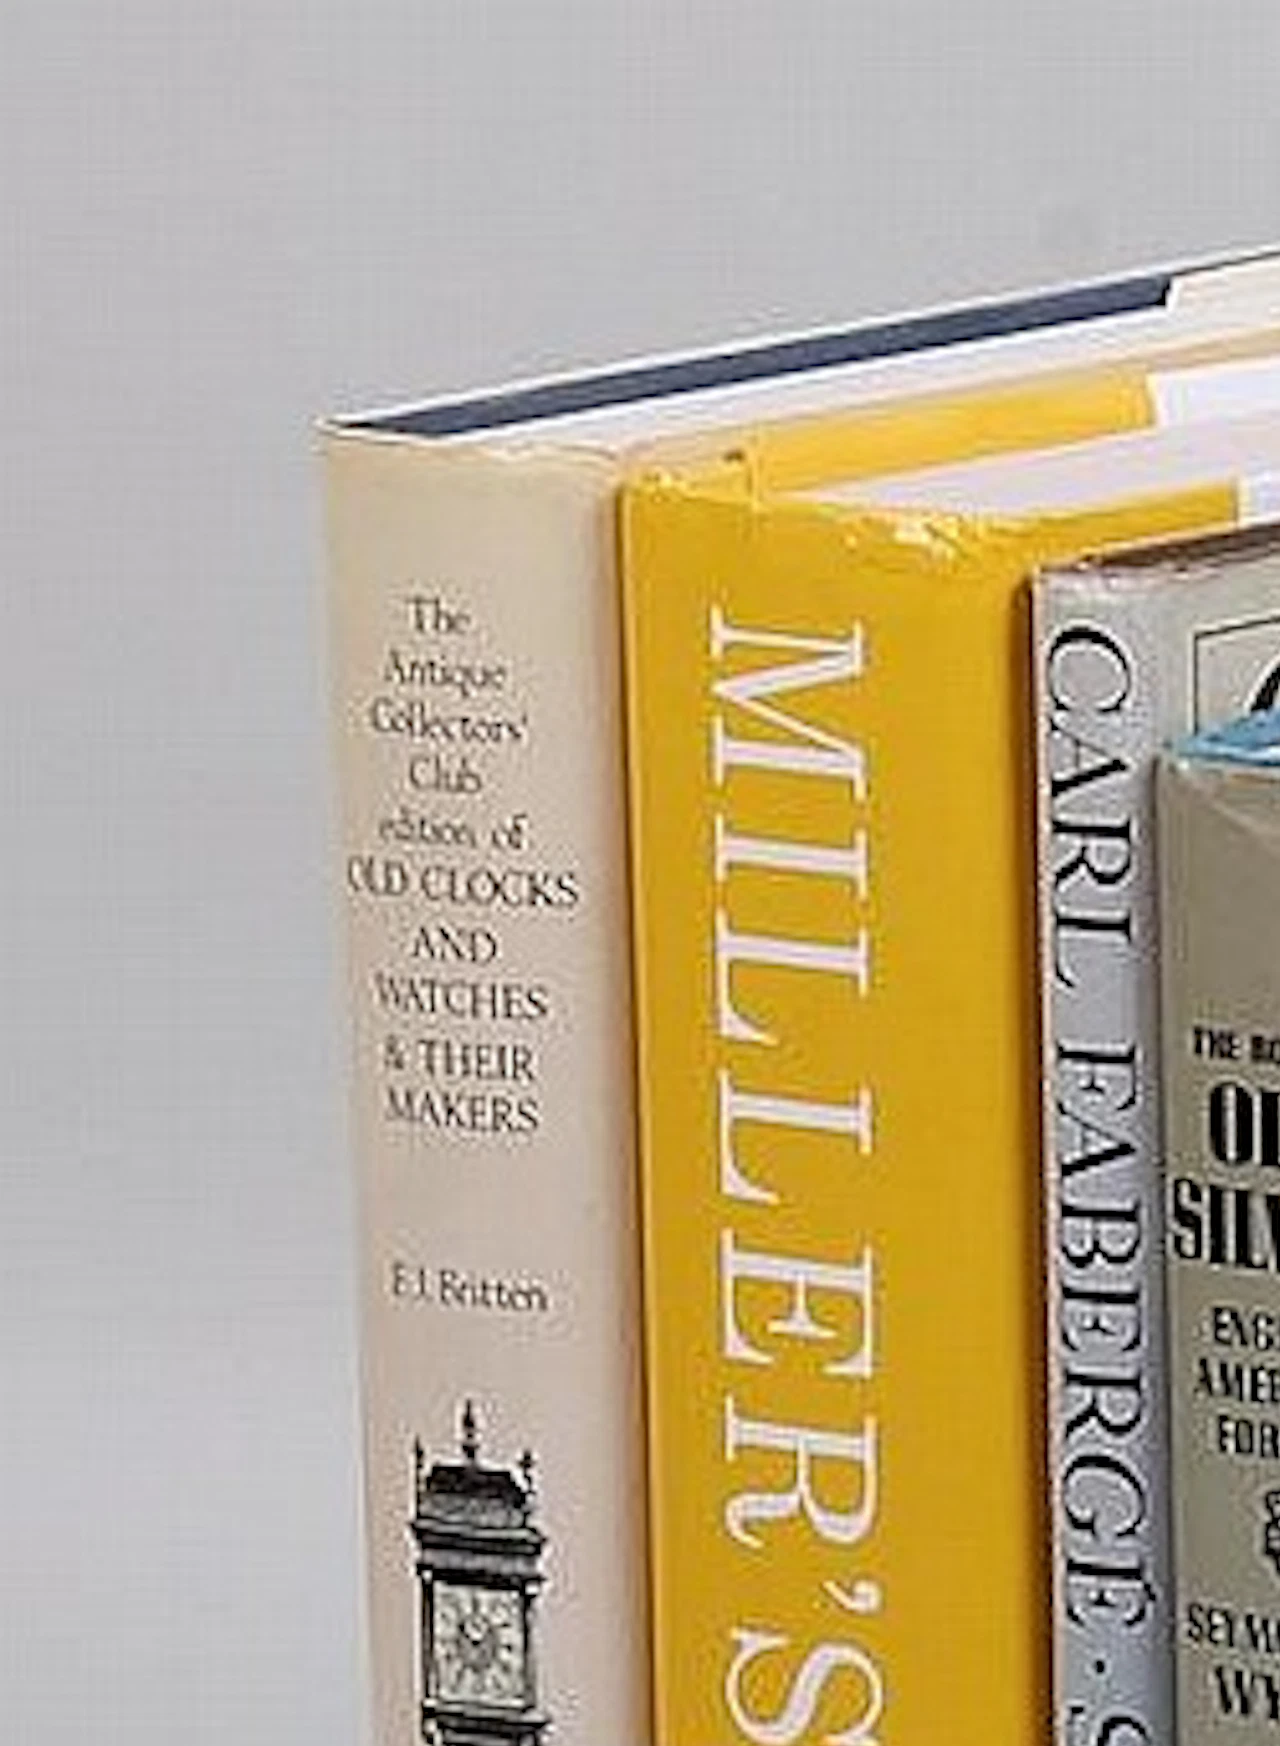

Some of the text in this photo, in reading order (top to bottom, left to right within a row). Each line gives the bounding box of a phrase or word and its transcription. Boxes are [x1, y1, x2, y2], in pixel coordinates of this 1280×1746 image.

[409, 596, 471, 637] The
[384, 650, 508, 698] Antique
[408, 758, 483, 796] Club
[1048, 625, 1133, 990] CARL
[379, 811, 528, 850] edition of
[347, 855, 580, 906] OLD CLOCKS
[410, 926, 499, 962] AND
[375, 972, 549, 1021] WATCHES
[384, 1040, 536, 1082] & THEIR
[1193, 1025, 1241, 1060] THE
[385, 1088, 541, 1133] MAKERS
